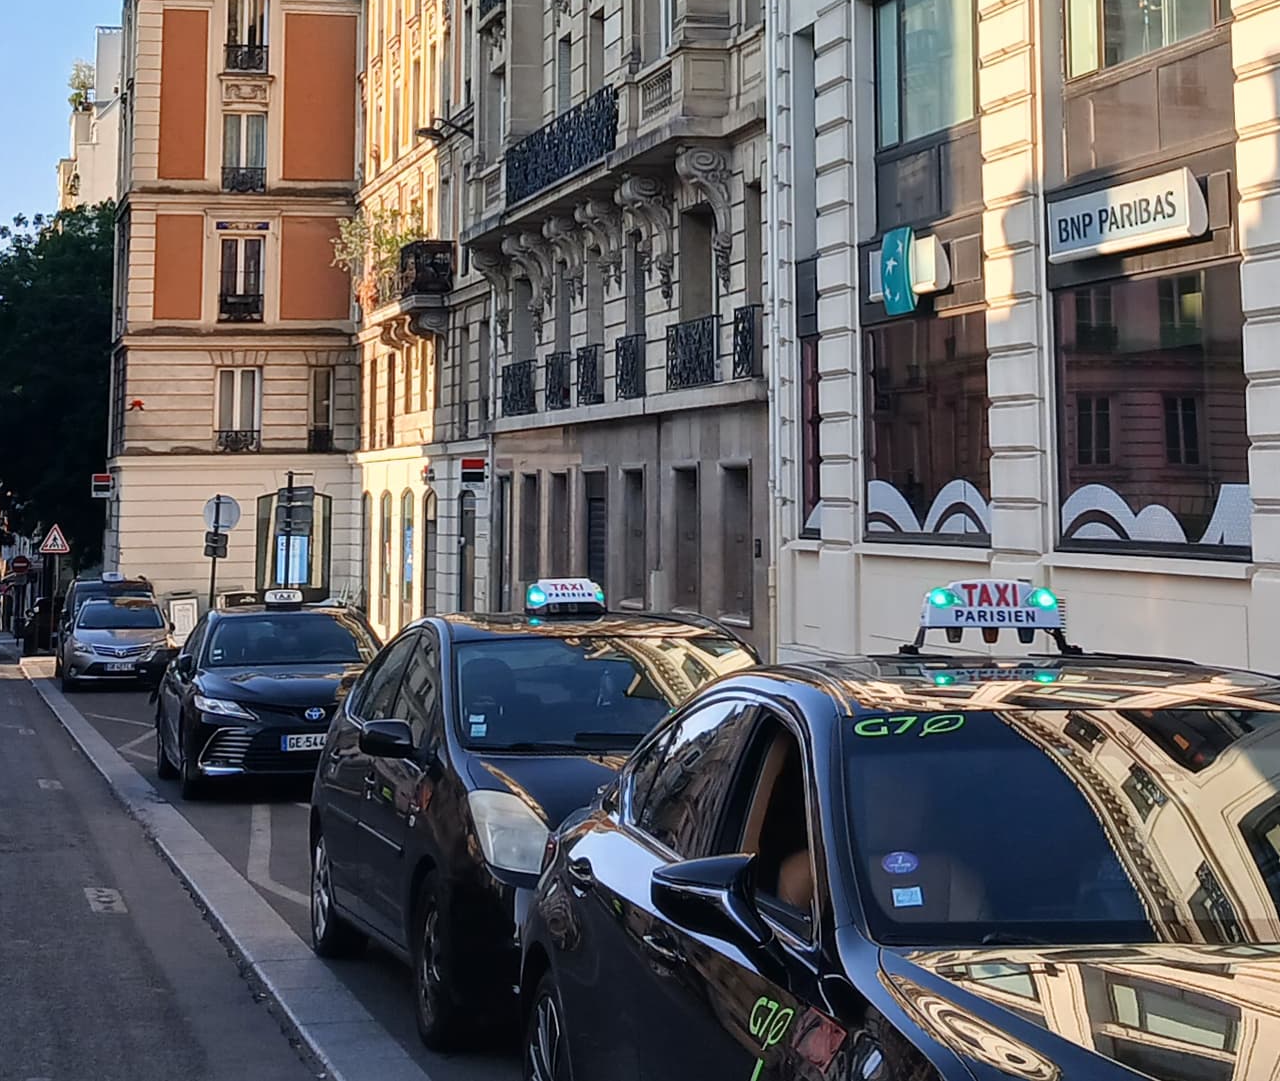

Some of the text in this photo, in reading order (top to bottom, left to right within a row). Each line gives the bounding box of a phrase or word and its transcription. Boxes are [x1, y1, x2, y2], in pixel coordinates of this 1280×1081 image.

[1058, 191, 1177, 243] BNP PARIBAS
[549, 583, 584, 591] TAXI
[961, 583, 1018, 607] TAXI
[954, 609, 1036, 623] PARISIEN
